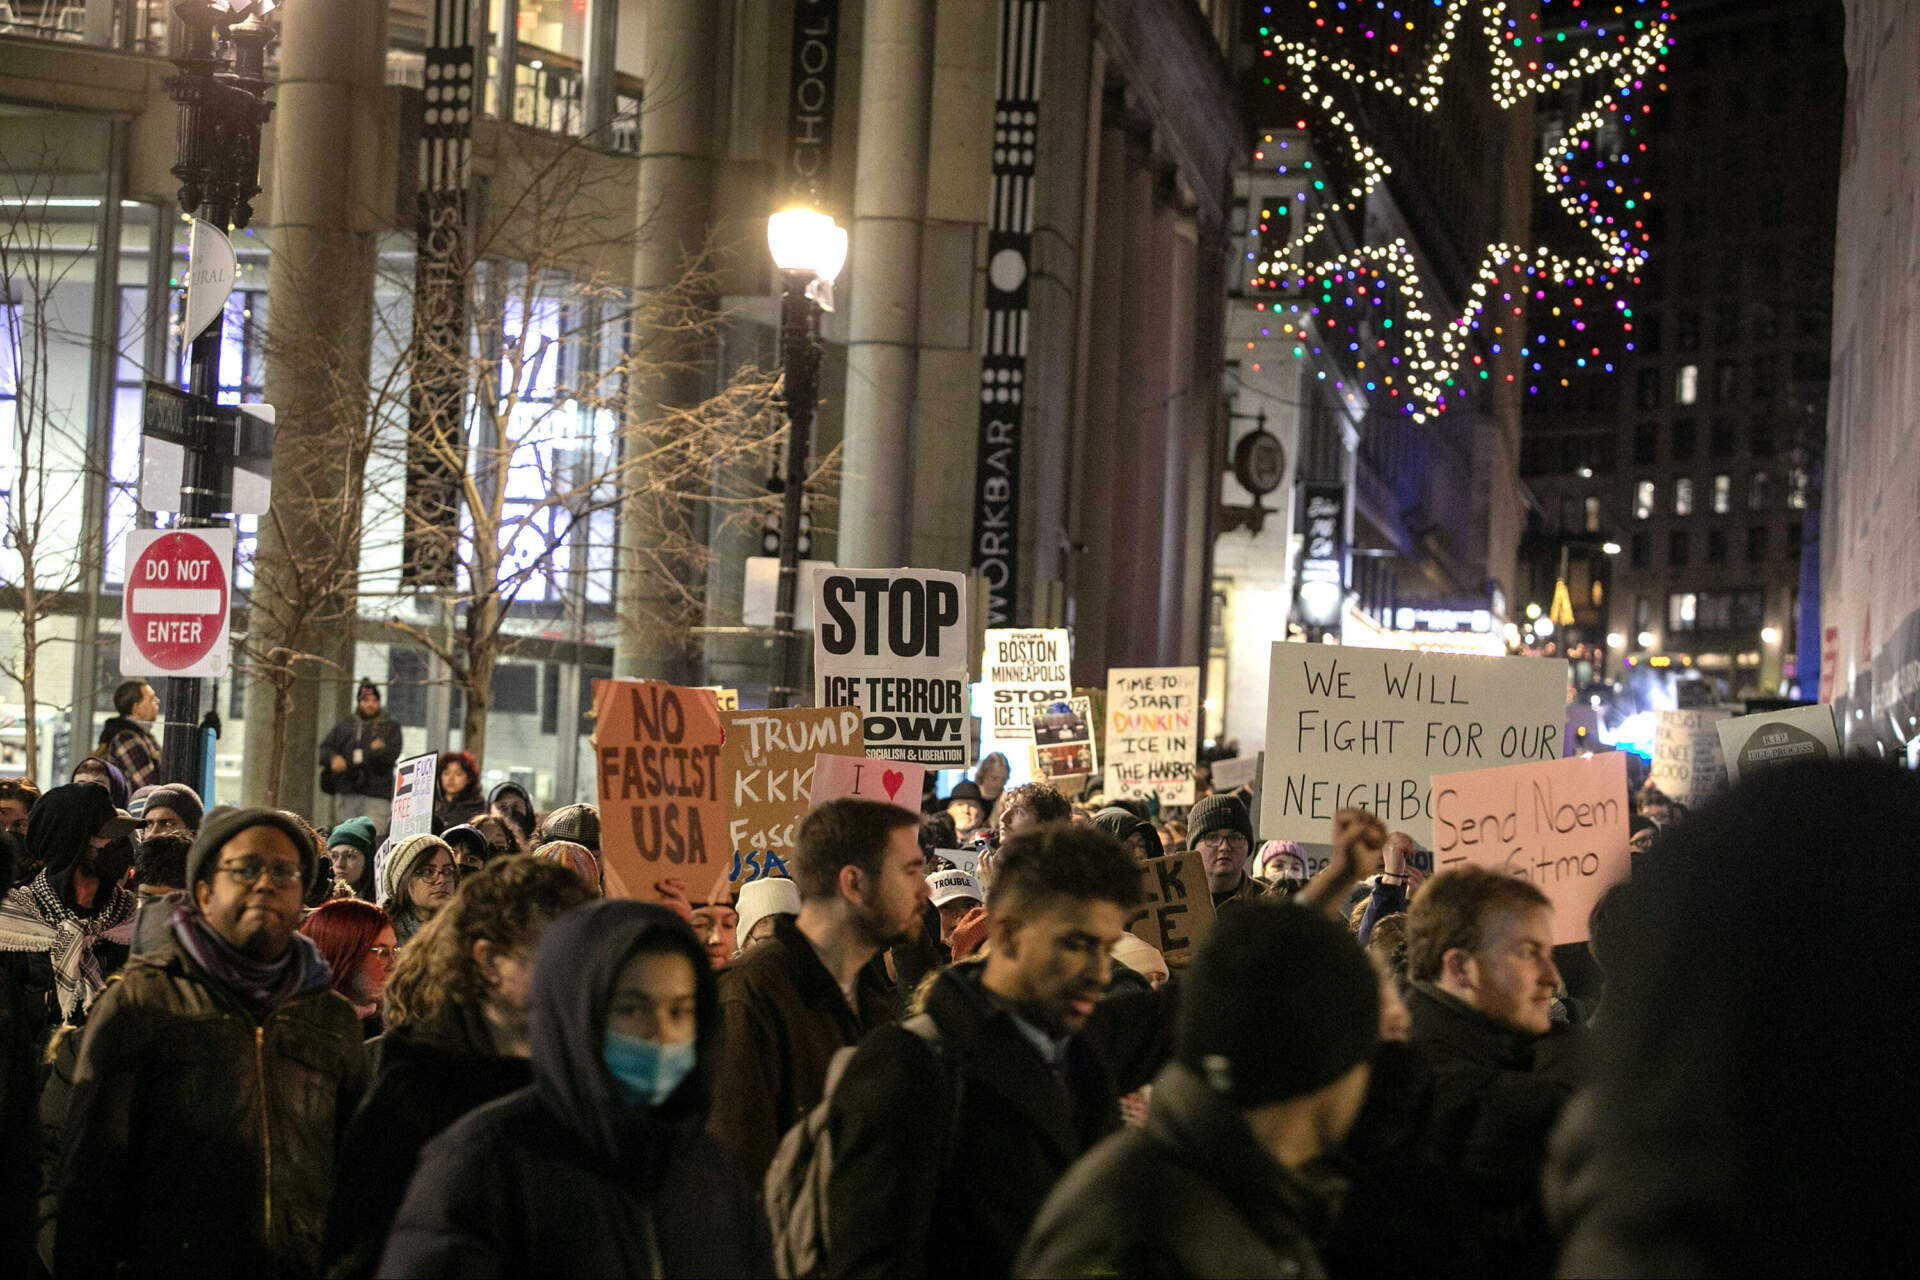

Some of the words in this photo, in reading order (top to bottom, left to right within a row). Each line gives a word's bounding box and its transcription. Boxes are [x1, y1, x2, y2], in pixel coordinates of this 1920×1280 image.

[793, 16, 830, 178] CHOOL
[979, 420, 1015, 627] WORKBAR
[145, 559, 169, 581] DO
[177, 559, 210, 581] NOT
[822, 575, 959, 657] STOP
[147, 621, 202, 643] ENTER
[998, 641, 1057, 663] BOSTON
[992, 665, 1066, 683] MINNEAPOLIS
[1117, 677, 1154, 692] TIME
[1161, 675, 1178, 690] TO
[1304, 659, 1356, 699] WE
[1384, 662, 1469, 704] WILL
[824, 676, 861, 708] ICE
[866, 678, 963, 715] TERROR
[993, 690, 1069, 703] STOP
[1129, 694, 1184, 710] START
[630, 686, 686, 745] NO
[864, 716, 964, 742] OW!
[994, 706, 1015, 726] ICE
[731, 711, 859, 758] TRUMP
[1121, 736, 1159, 754] ICE
[1167, 736, 1186, 752] IN
[1298, 710, 1405, 755] FIGHT
[1426, 722, 1483, 758] FOR
[1501, 724, 1557, 760] OUR
[866, 748, 906, 761] SOCIALISM
[907, 749, 917, 761] &
[918, 748, 963, 761] LIBERATION
[1776, 743, 1816, 757] PROCESS
[601, 744, 721, 801] FASCIST
[851, 764, 864, 795] I
[1110, 762, 1142, 779] THE
[1148, 760, 1195, 780] HARBOR
[735, 766, 815, 808] KKK
[393, 797, 412, 819] FREE
[1437, 780, 1519, 851] Send
[1533, 779, 1619, 834] Noem
[630, 802, 708, 865] USA
[730, 814, 800, 854] Fasc
[1504, 846, 1599, 885] Gitmo
[934, 877, 972, 890] TROUBLE
